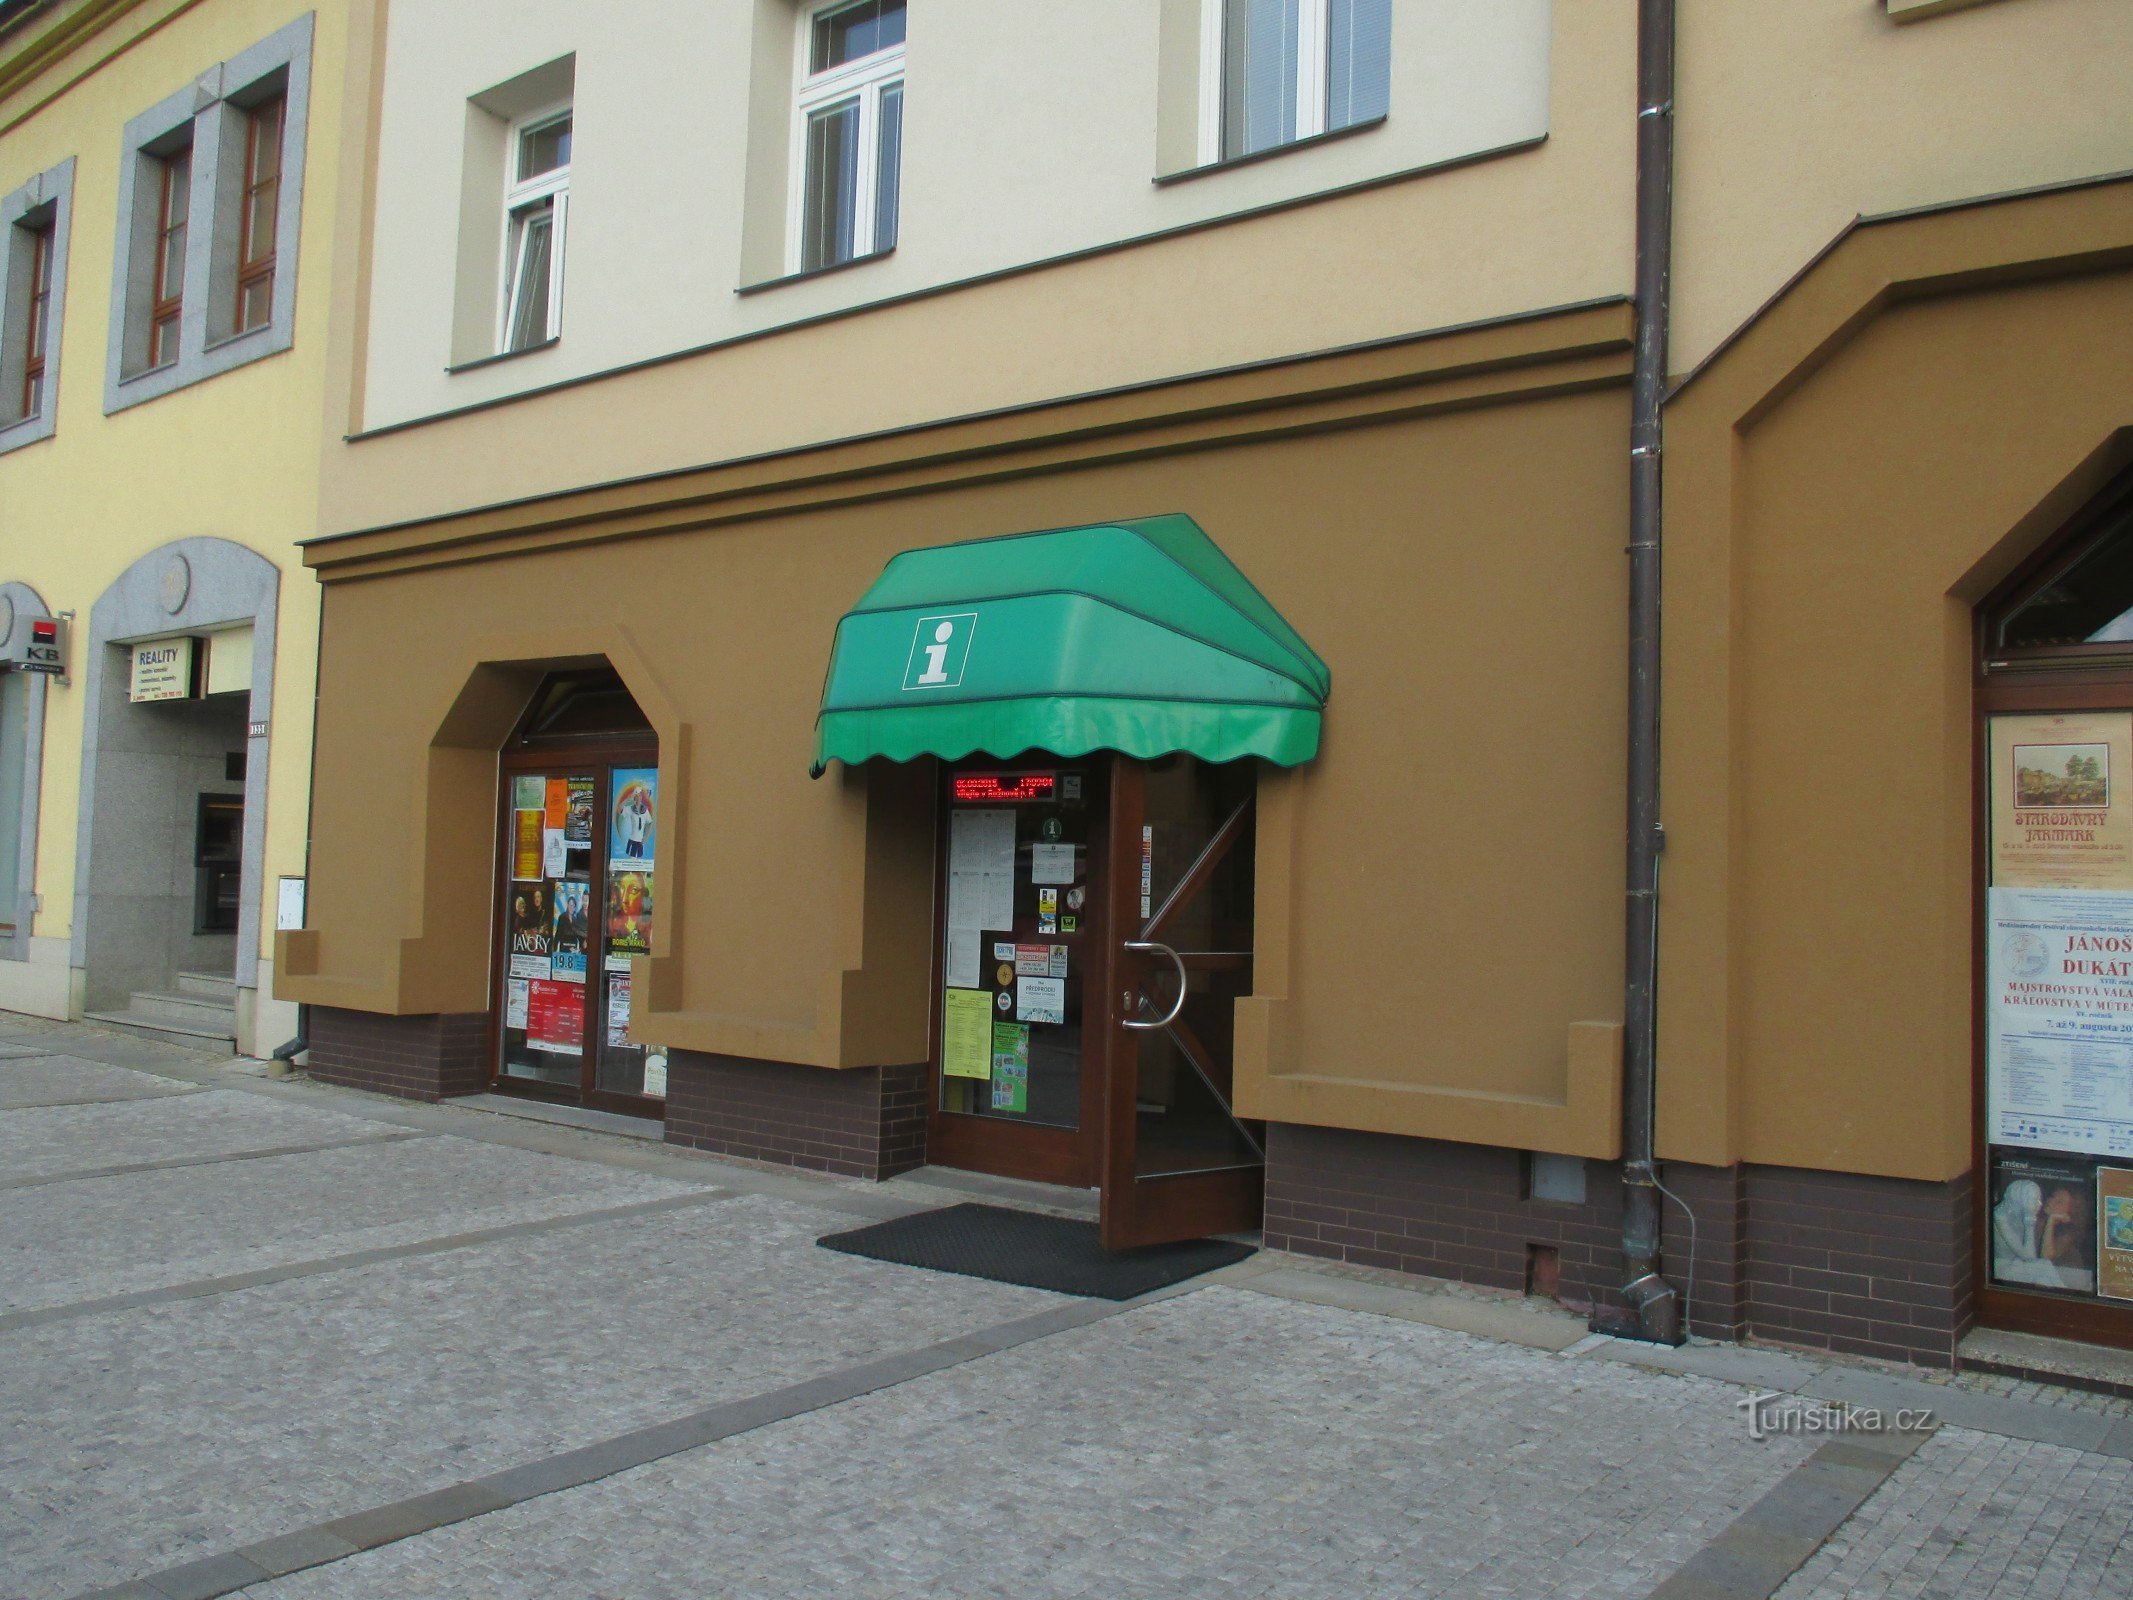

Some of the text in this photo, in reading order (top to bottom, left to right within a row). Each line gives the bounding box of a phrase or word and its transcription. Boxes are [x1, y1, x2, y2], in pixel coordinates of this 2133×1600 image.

[26, 647, 60, 660] KB
[139, 648, 178, 665] REALITY
[918, 621, 953, 684] i
[2015, 810, 2107, 826] STARODÁVNÝ
[2025, 829, 2095, 842] JARMARK
[513, 933, 551, 954] JAVORY
[2064, 933, 2132, 953] JÁNOŠ
[2008, 982, 2099, 996] MAJSTROVSTVÁ
[2085, 1000, 2092, 1009] V
[2046, 1020, 2054, 1028] 7.
[2056, 1020, 2067, 1029] až
[2068, 1021, 2078, 1030] 9.
[2080, 1023, 2118, 1032] augusta
